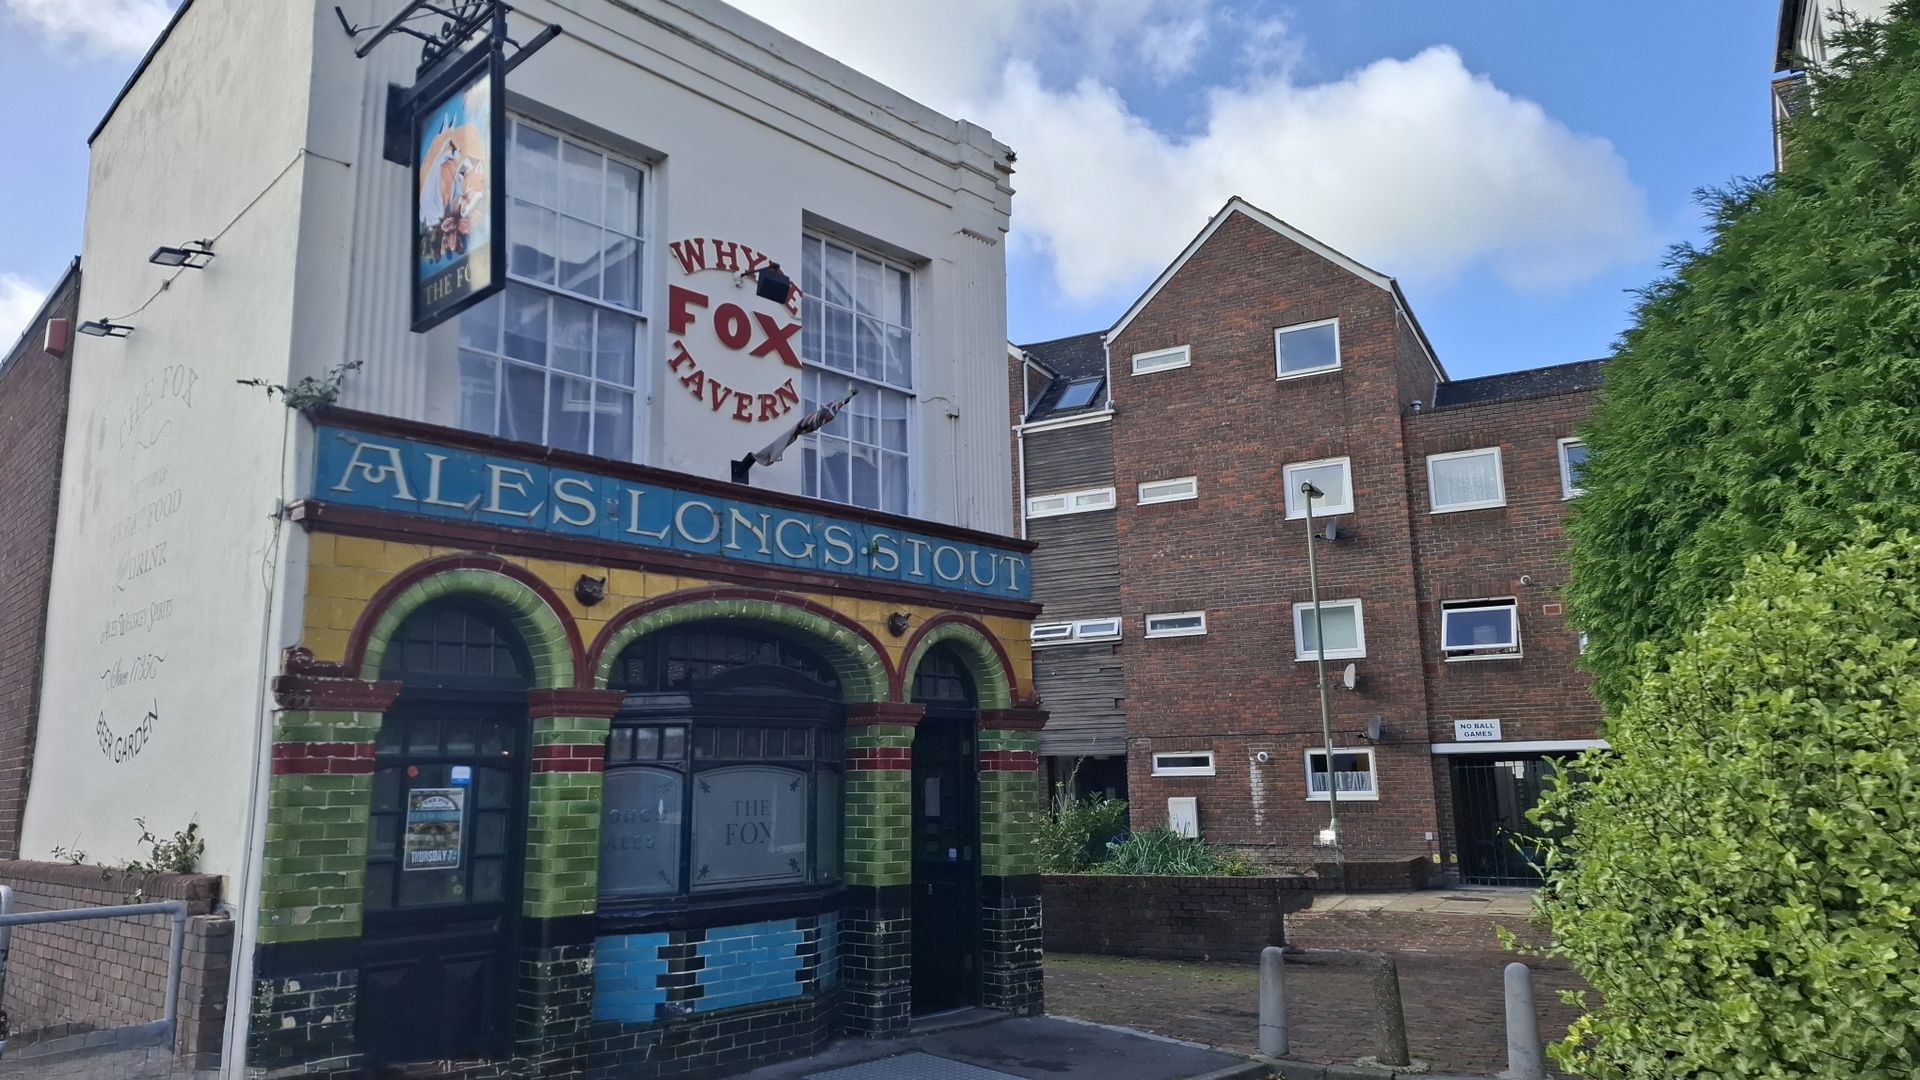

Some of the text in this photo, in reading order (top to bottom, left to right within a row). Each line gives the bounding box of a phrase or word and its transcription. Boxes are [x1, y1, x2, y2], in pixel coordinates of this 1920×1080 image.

[424, 273, 453, 305] THE
[669, 237, 803, 316] WHYE
[668, 284, 804, 369] FOX
[159, 363, 199, 409] FOX
[668, 339, 801, 422] TAVERN
[146, 488, 183, 527] FOOD
[331, 441, 1026, 592] ALES LONGS STOUT
[127, 541, 169, 581] DRINK
[96, 697, 159, 764] BEER GARDEN
[1463, 730, 1493, 738] GAMES
[731, 799, 771, 817] THE
[725, 821, 775, 846] FOX
[411, 849, 448, 863] THURSDAY
